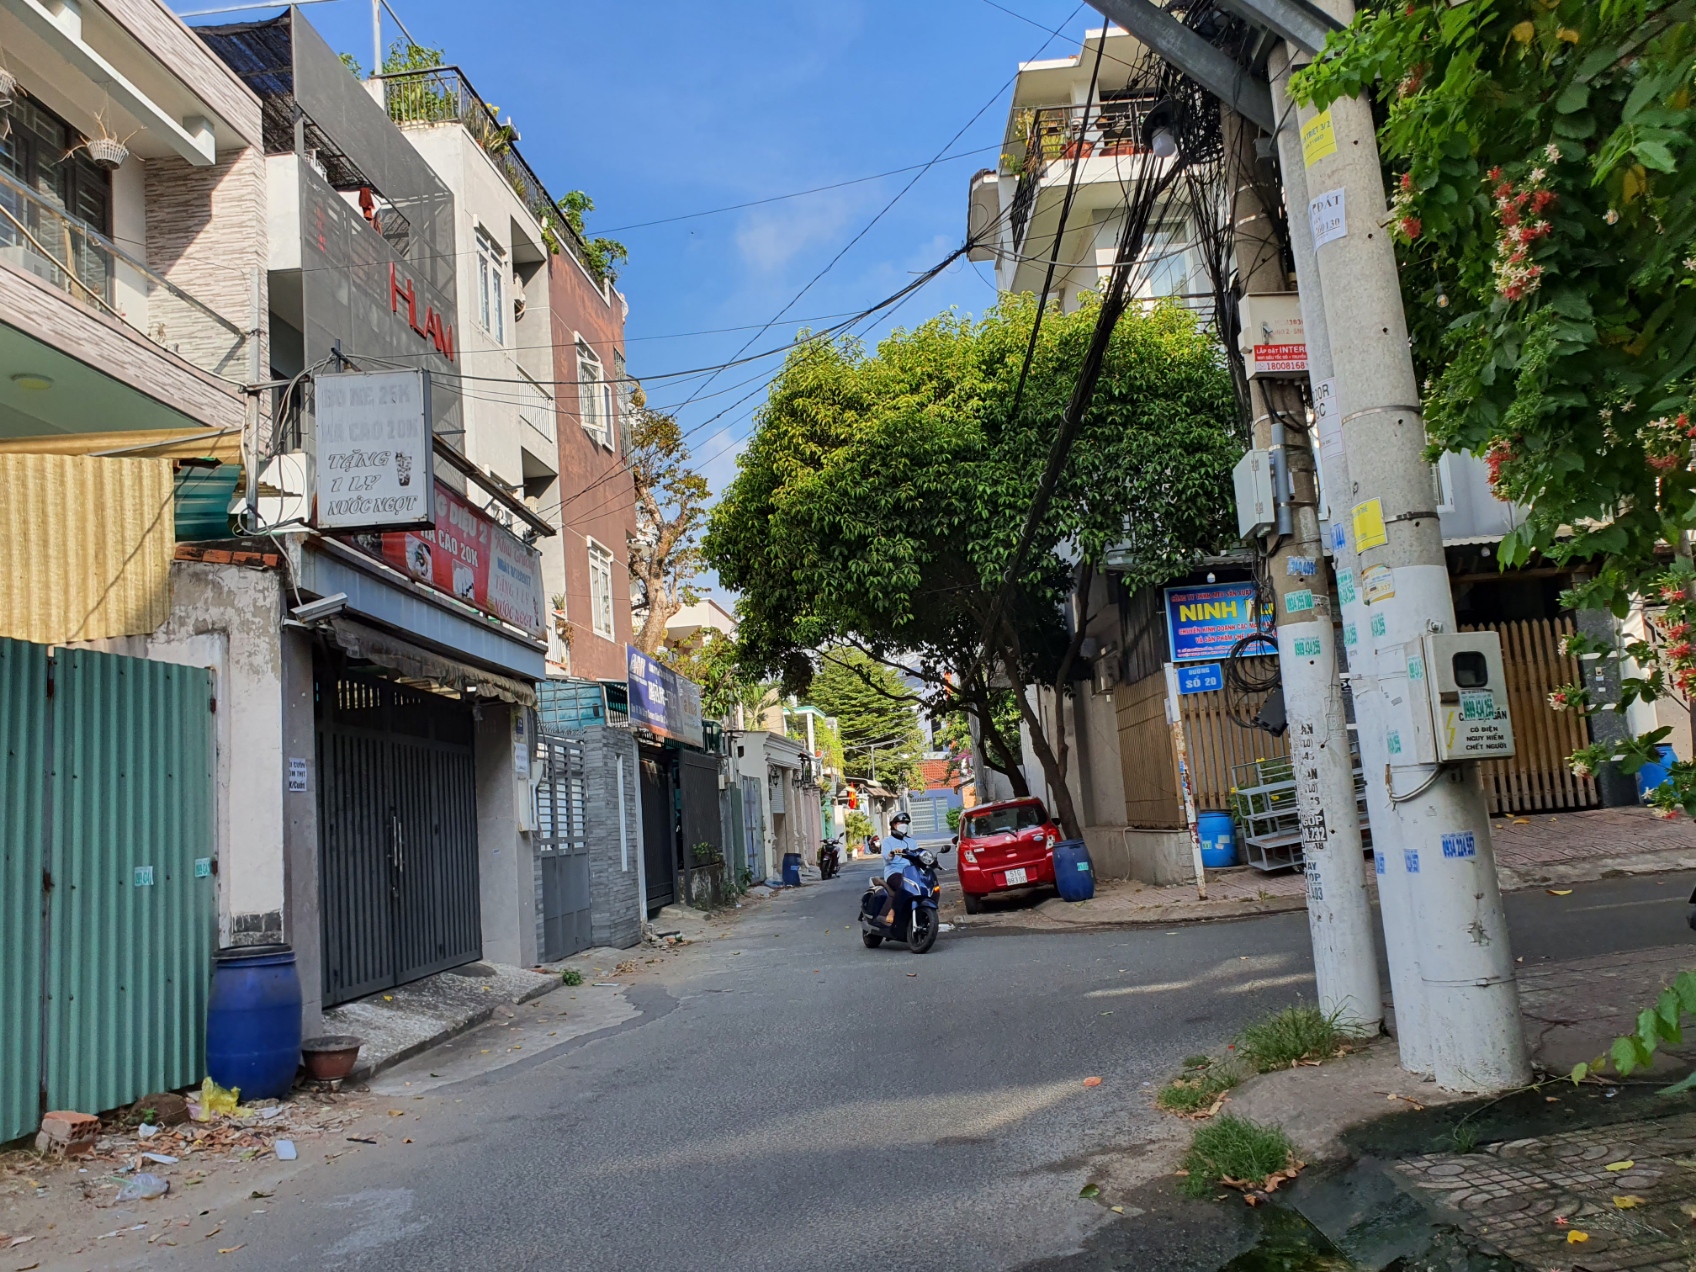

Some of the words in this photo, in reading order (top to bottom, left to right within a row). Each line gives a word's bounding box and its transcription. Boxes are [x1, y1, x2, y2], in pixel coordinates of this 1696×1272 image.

[328, 449, 392, 472] TẶNG
[348, 475, 382, 491] LY
[327, 495, 372, 516] NƯỚC
[372, 495, 418, 515] NGỌT
[460, 542, 479, 568] 20K
[1179, 600, 1238, 622] NINH
[1186, 675, 1201, 688] SỐ
[1205, 677, 1217, 686] 20
[1466, 743, 1484, 751] CHẾT
